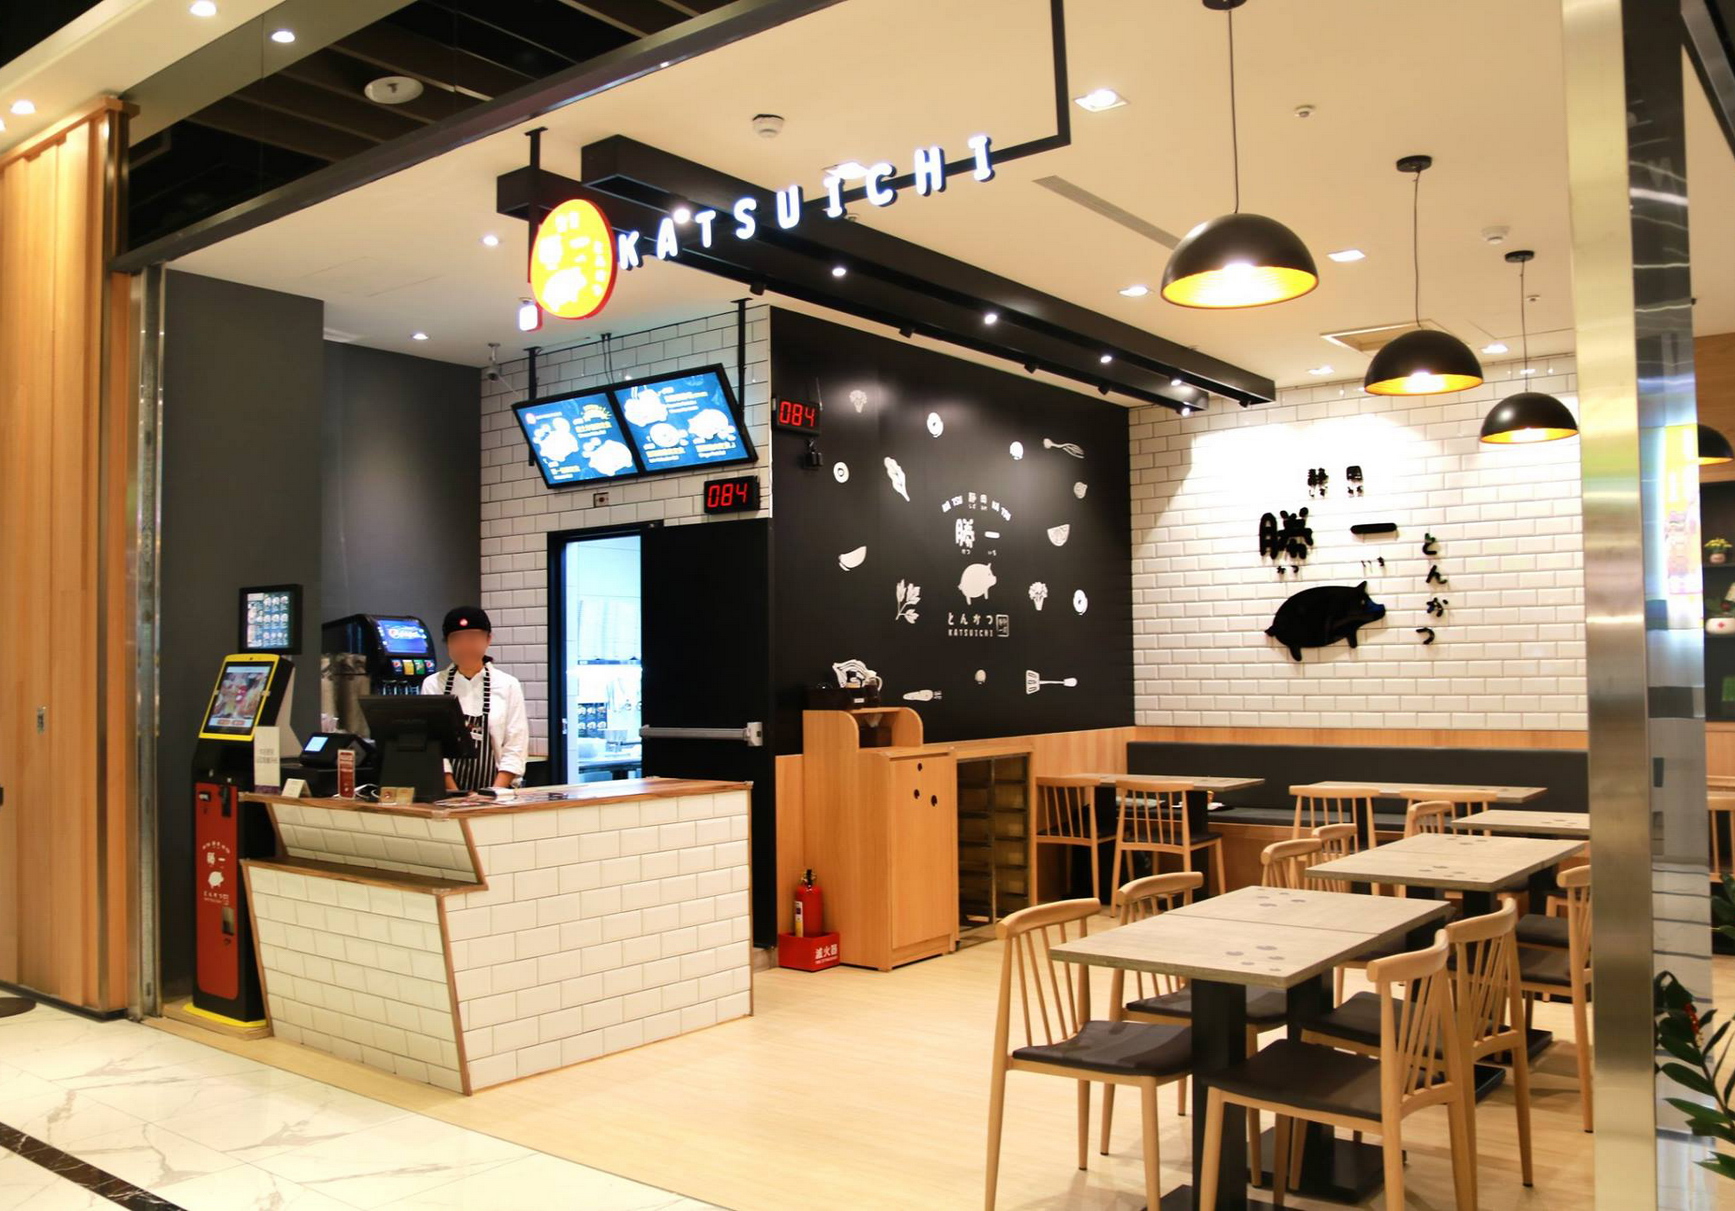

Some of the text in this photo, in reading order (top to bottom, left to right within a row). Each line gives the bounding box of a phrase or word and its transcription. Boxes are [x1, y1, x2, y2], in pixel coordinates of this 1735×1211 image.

[618, 135, 994, 270] KATSUICHI
[779, 401, 816, 428] 084
[707, 483, 748, 508] 084
[1416, 533, 1449, 645] とんかつ
[947, 612, 994, 626] とんかつ
[948, 629, 994, 637] KATSUICHI
